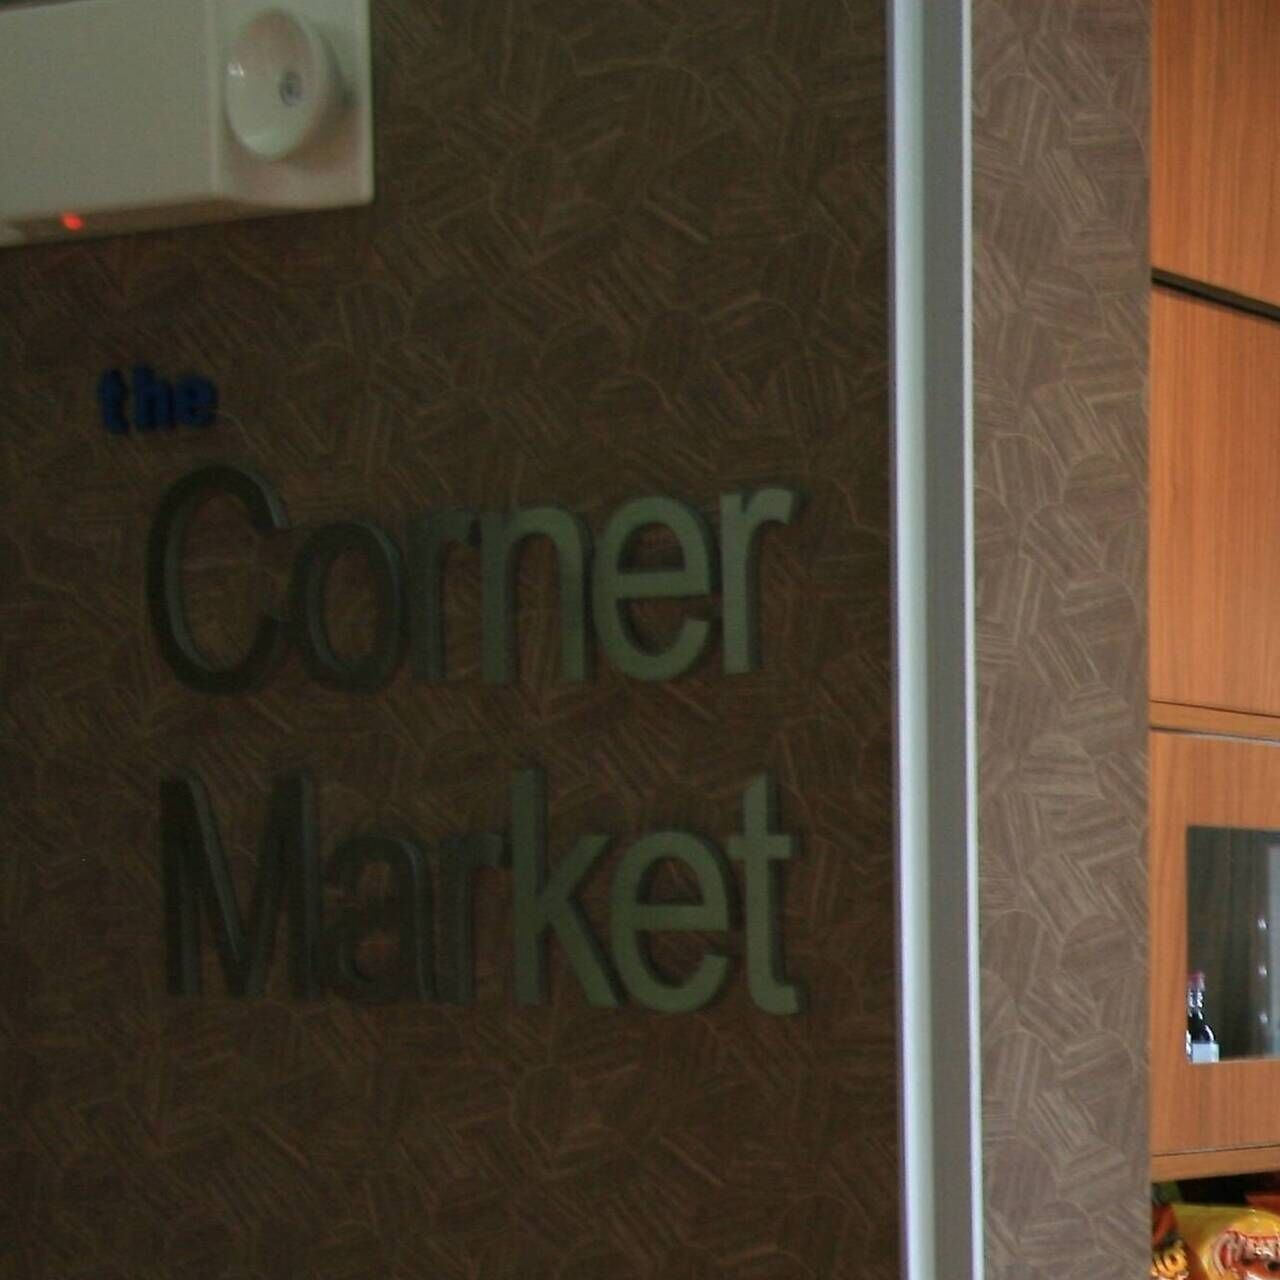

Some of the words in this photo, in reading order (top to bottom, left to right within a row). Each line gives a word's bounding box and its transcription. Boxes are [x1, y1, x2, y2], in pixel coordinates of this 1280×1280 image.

[97, 365, 217, 433] the
[144, 462, 804, 696] Corner
[157, 764, 798, 1016] Market
